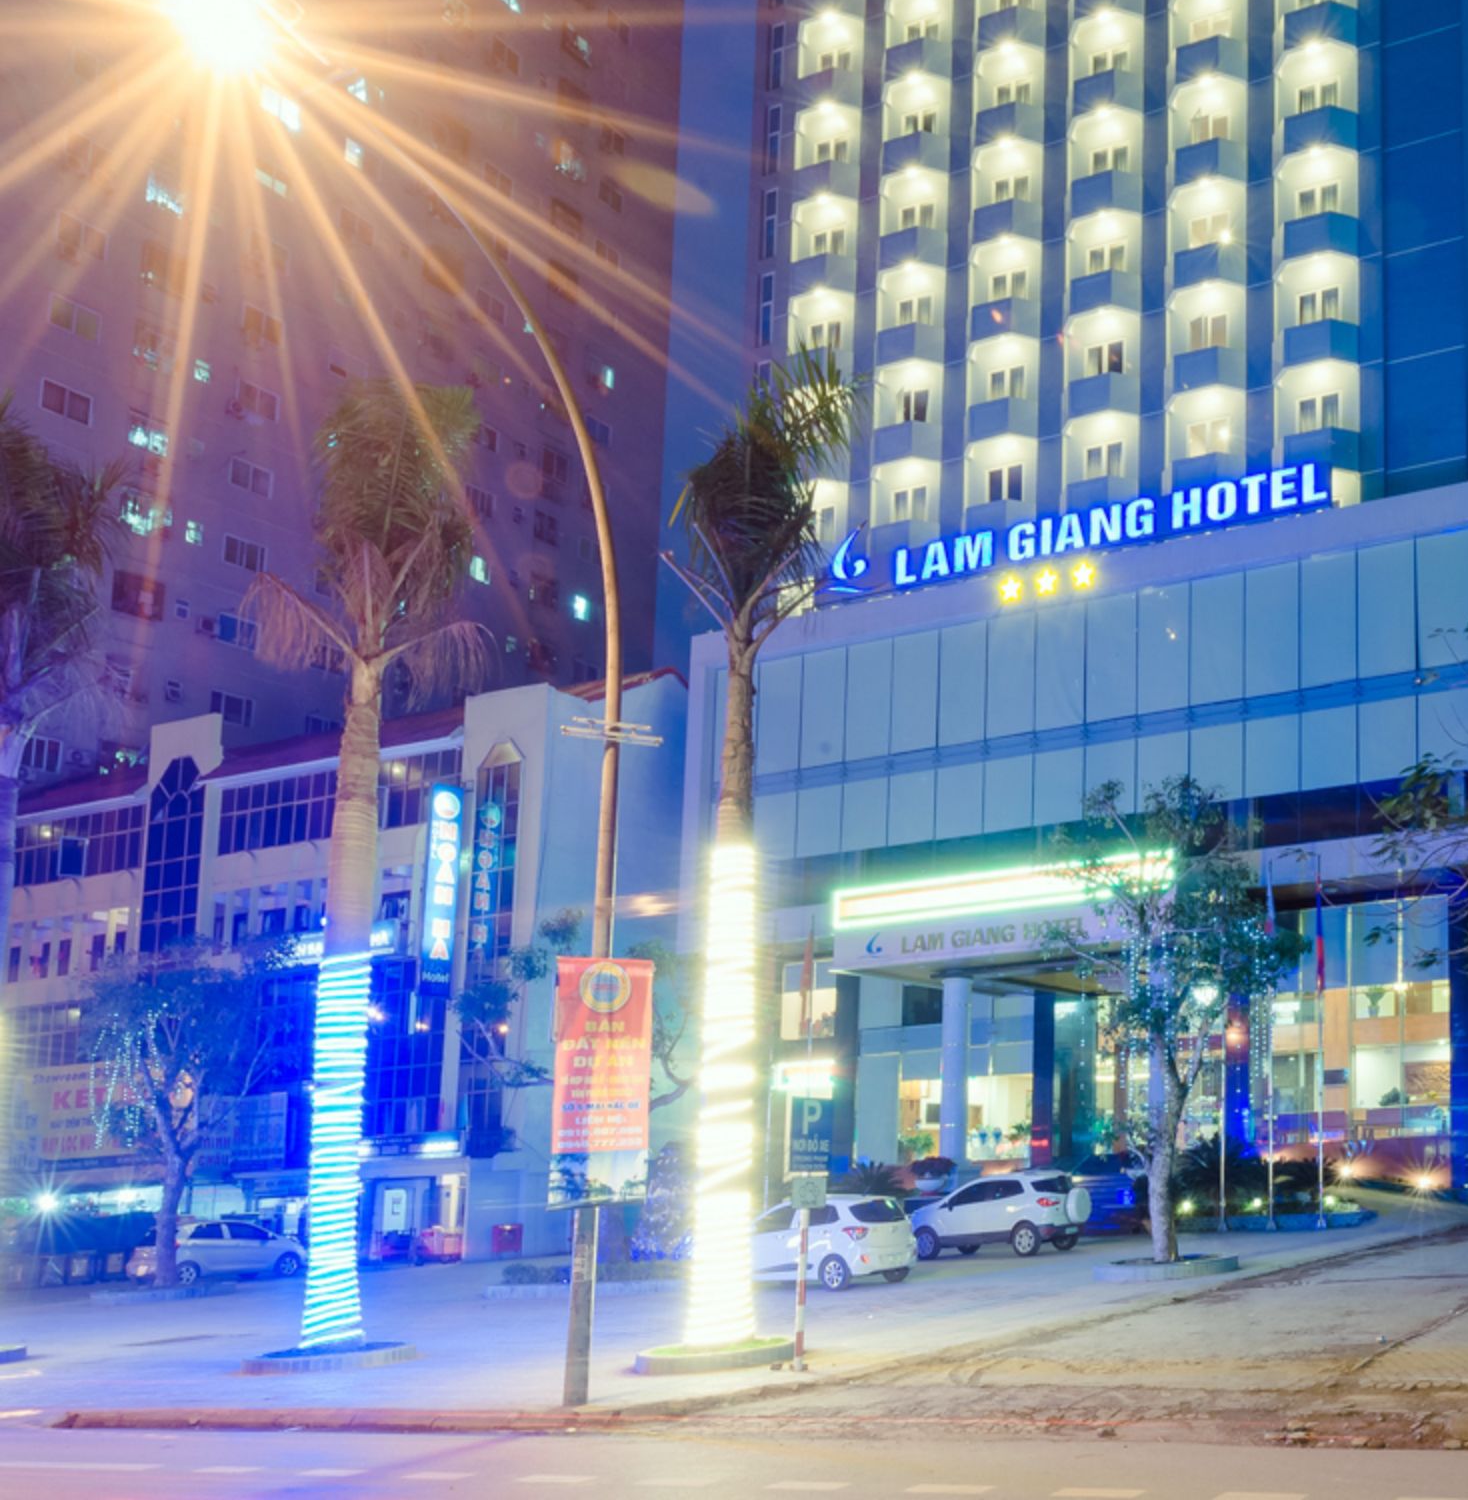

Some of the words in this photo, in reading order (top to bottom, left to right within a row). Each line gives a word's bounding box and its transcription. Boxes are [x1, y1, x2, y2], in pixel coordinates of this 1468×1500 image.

[894, 531, 993, 585] LAM
[1008, 497, 1155, 562] GIANG
[1170, 462, 1328, 529] HOTEL
[901, 932, 944, 954] LAM
[951, 924, 1016, 949] GIANG
[1023, 918, 1088, 940] HOTEL
[802, 1100, 822, 1135] P
